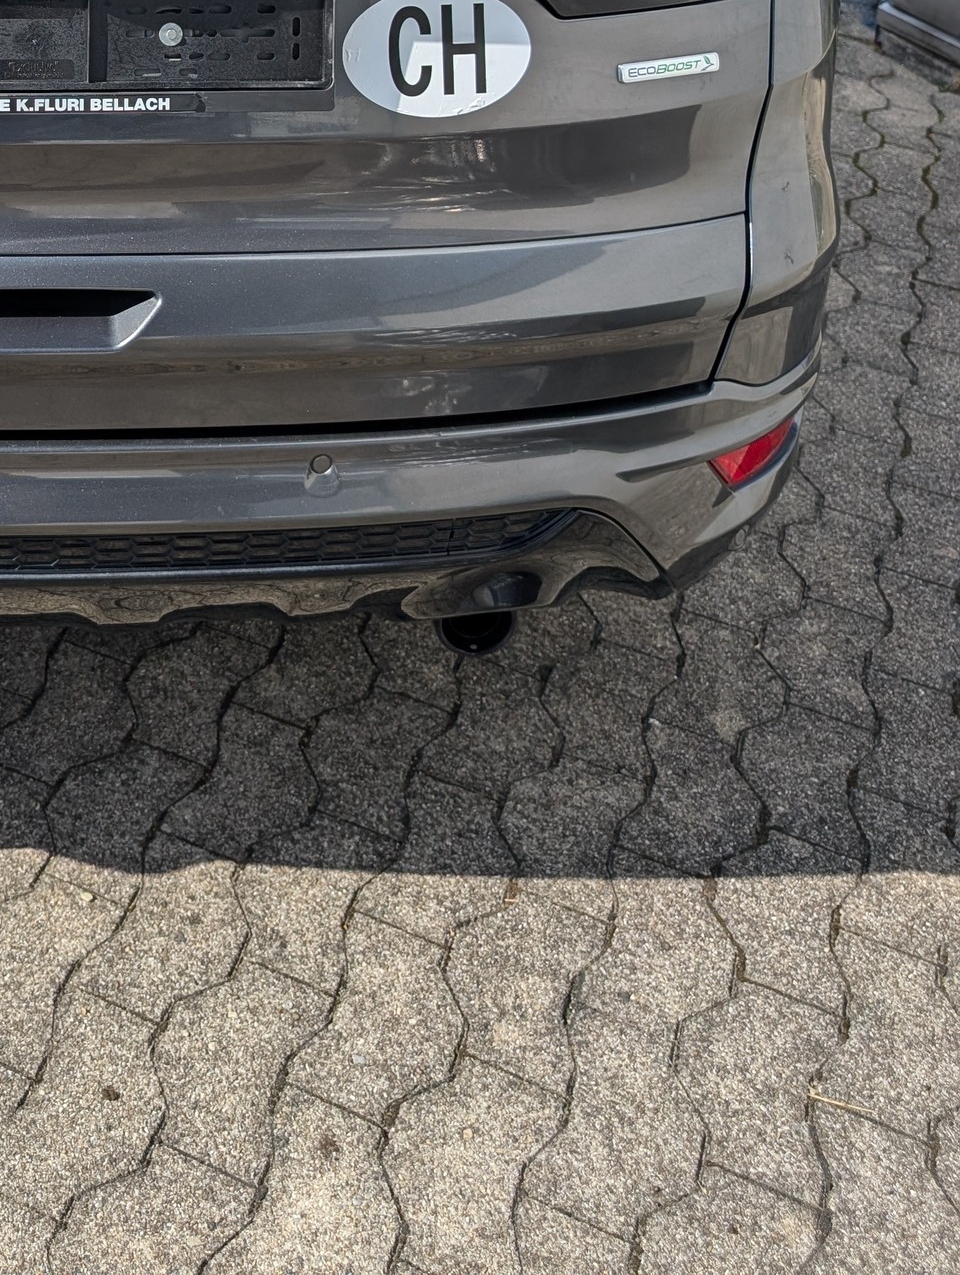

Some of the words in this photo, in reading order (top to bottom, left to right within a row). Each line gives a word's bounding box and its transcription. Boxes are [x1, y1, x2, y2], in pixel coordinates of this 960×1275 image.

[388, 3, 487, 97] CH
[628, 60, 702, 78] ECOBOOST
[16, 98, 84, 112] K.FLURI
[90, 97, 171, 112] BELLACH
